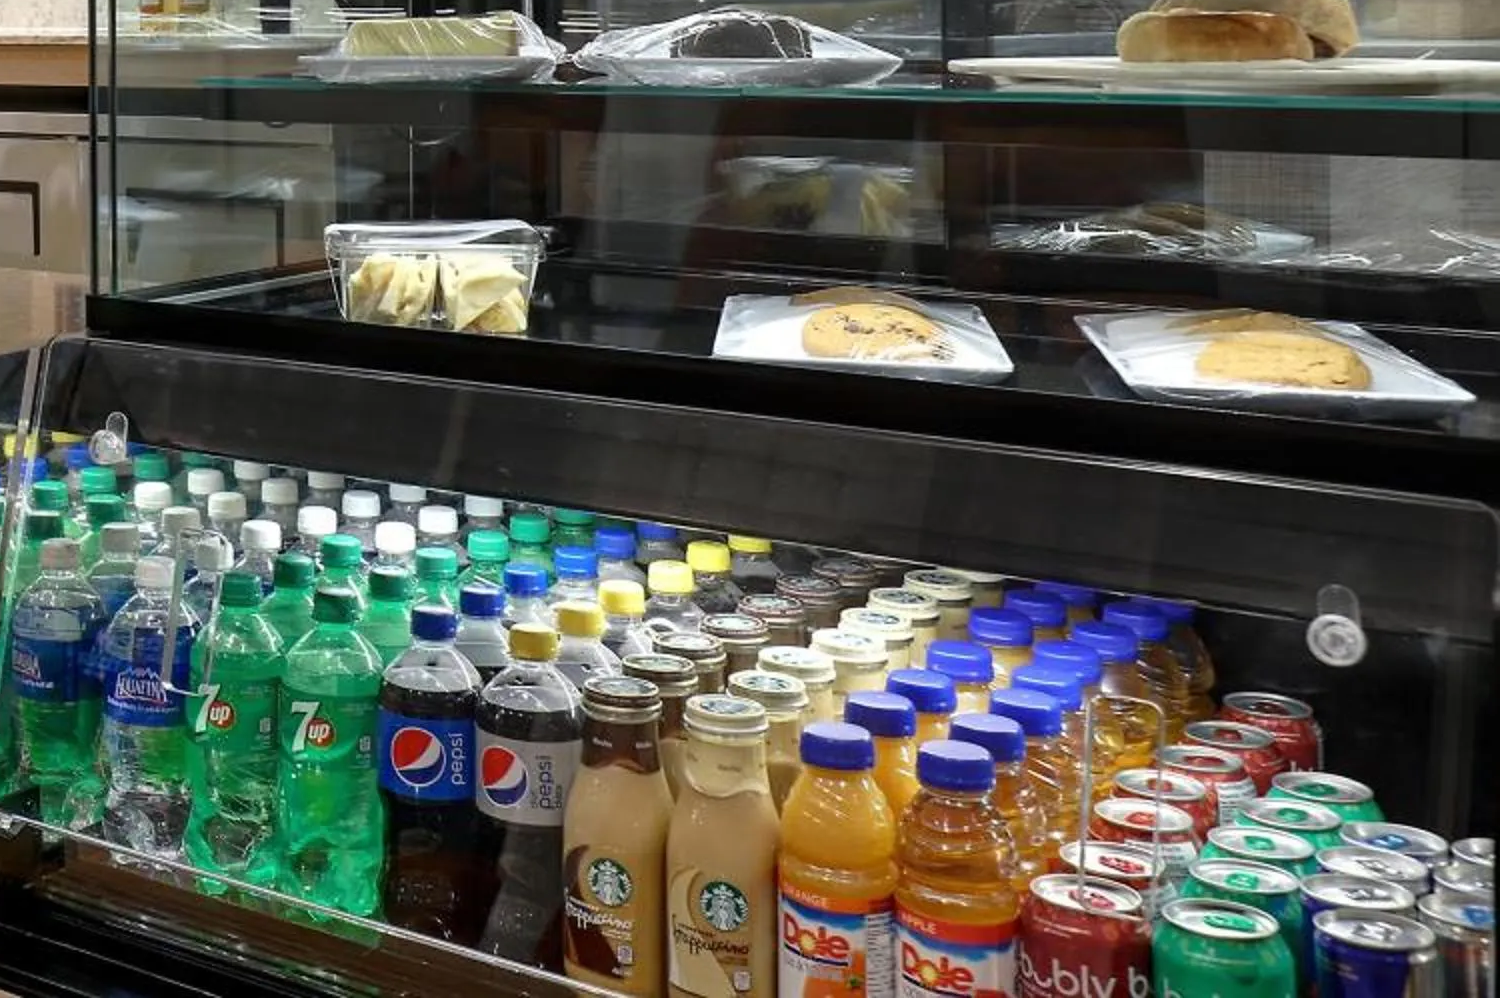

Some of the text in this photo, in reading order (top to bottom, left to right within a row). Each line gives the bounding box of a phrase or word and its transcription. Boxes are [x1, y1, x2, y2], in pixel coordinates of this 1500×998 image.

[448, 732, 468, 785] pepsi
[535, 755, 555, 809] pepsi
[784, 912, 850, 959] Dole
[902, 941, 975, 992] Dole
